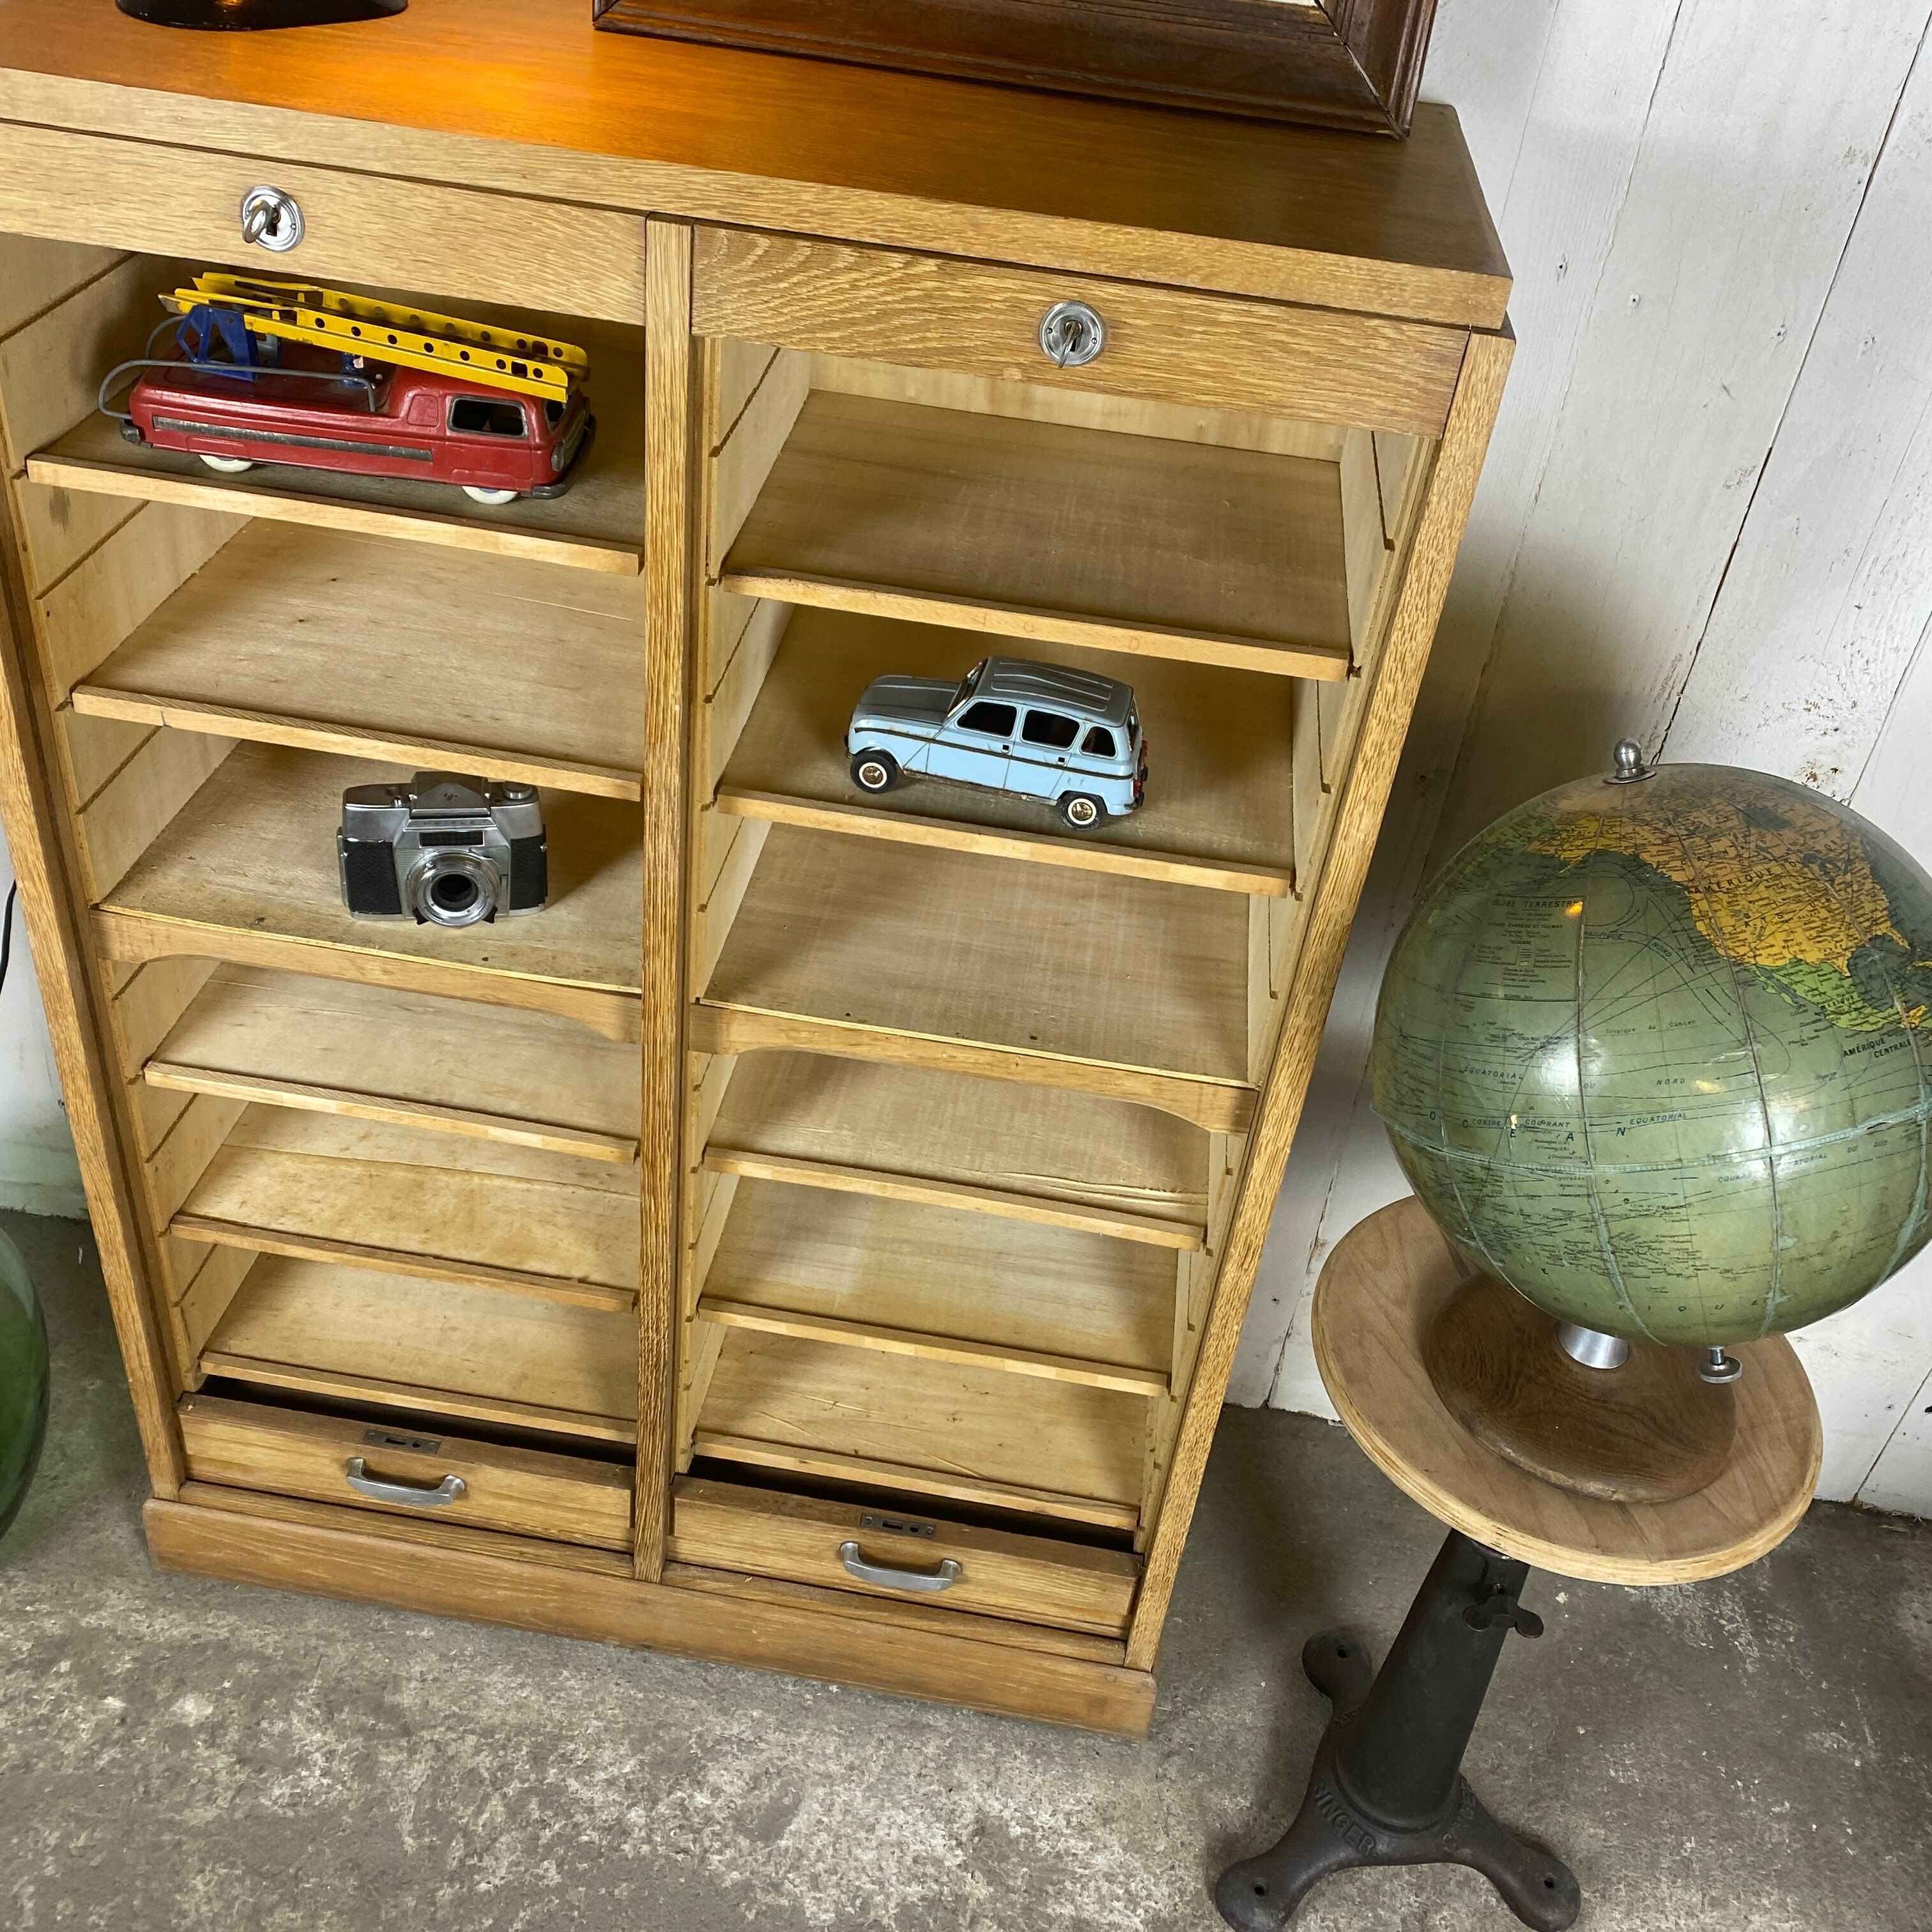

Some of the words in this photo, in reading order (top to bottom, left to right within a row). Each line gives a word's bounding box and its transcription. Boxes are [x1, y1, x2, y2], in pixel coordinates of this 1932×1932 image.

[1492, 898, 1516, 907] GLOBE
[1651, 942, 1673, 958] NORD
[1669, 1020, 1696, 1028] Cancer
[1843, 1037, 1886, 1057] AMÉRIQUE
[1873, 1039, 1912, 1058] CENTRALE
[1472, 1118, 1501, 1126] CONTRE
[1525, 1119, 1570, 1128] COURANT
[1314, 1781, 1376, 1857] SINGER
